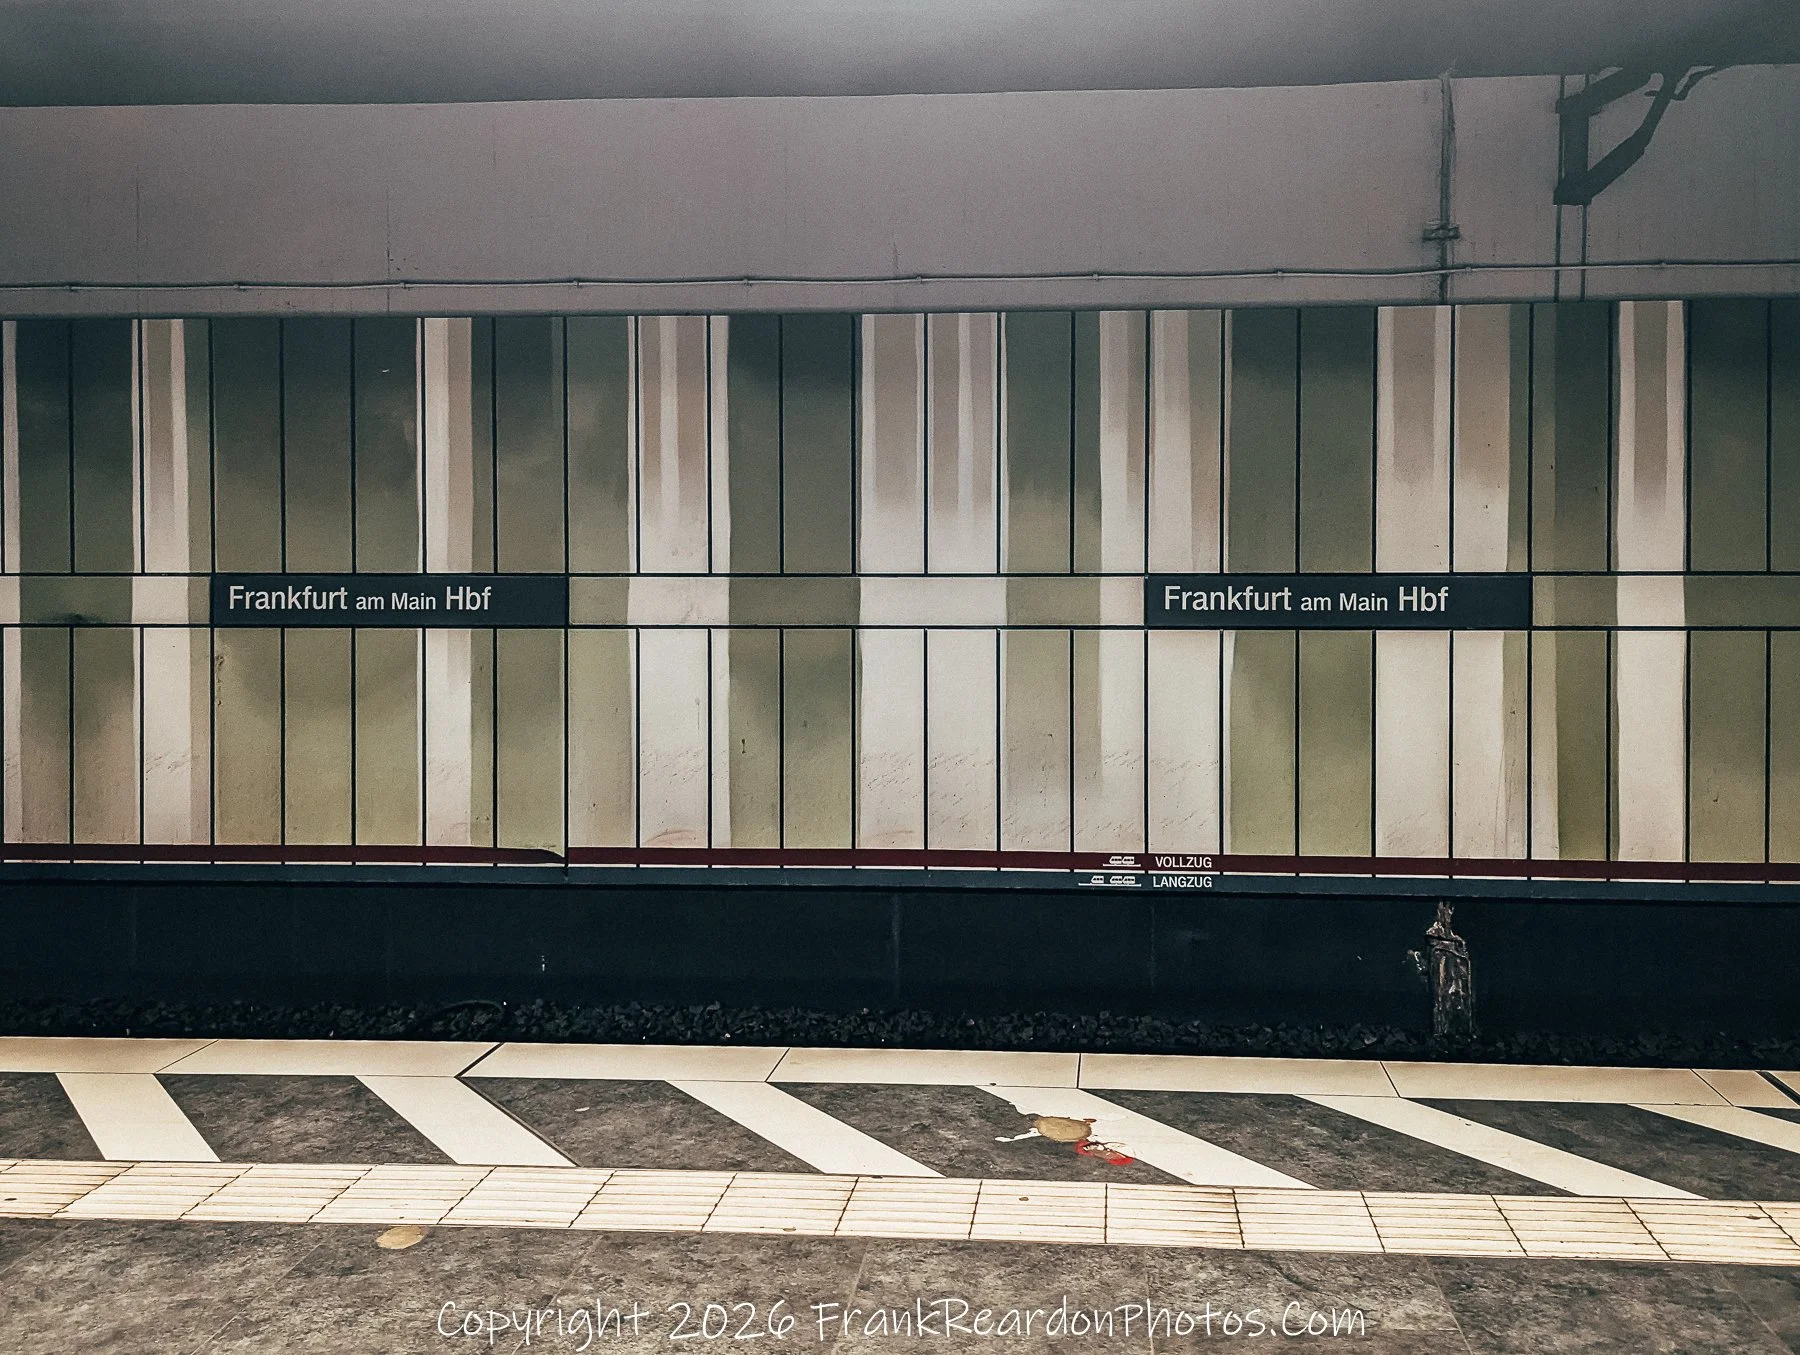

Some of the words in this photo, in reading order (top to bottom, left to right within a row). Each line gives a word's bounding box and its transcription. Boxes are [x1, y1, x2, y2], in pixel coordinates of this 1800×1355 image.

[229, 585, 348, 610] Frankfurt
[355, 596, 385, 611] am
[391, 592, 436, 610] Main
[446, 586, 492, 611] Hbf
[1164, 585, 1292, 611] Frankfurt
[1300, 596, 1332, 611] am
[1339, 592, 1388, 612] Main
[1398, 586, 1449, 612] Hbf
[1155, 856, 1212, 868] VOLLZUG
[1153, 876, 1212, 888] LANGZUG
